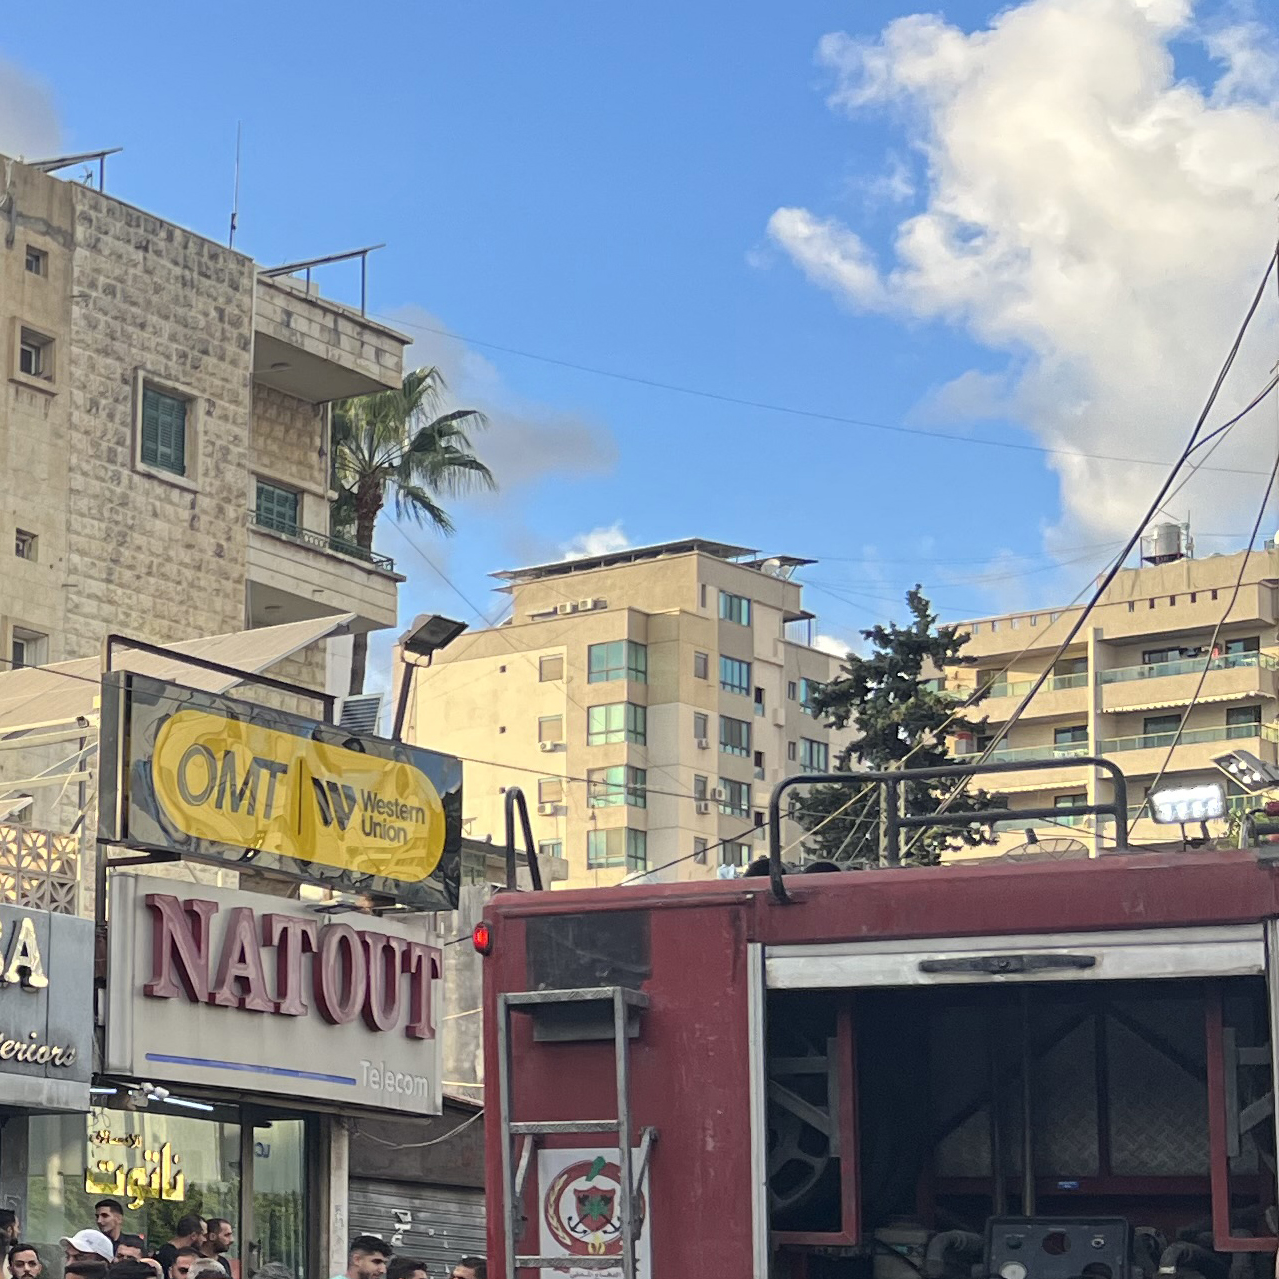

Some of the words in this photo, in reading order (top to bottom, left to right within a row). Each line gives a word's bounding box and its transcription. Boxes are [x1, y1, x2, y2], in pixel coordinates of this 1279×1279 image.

[176, 743, 289, 821] OMT
[360, 789, 426, 825] Western
[361, 814, 408, 846] Union
[143, 891, 444, 1041] NATOUT
[359, 1058, 429, 1098] Telecom
